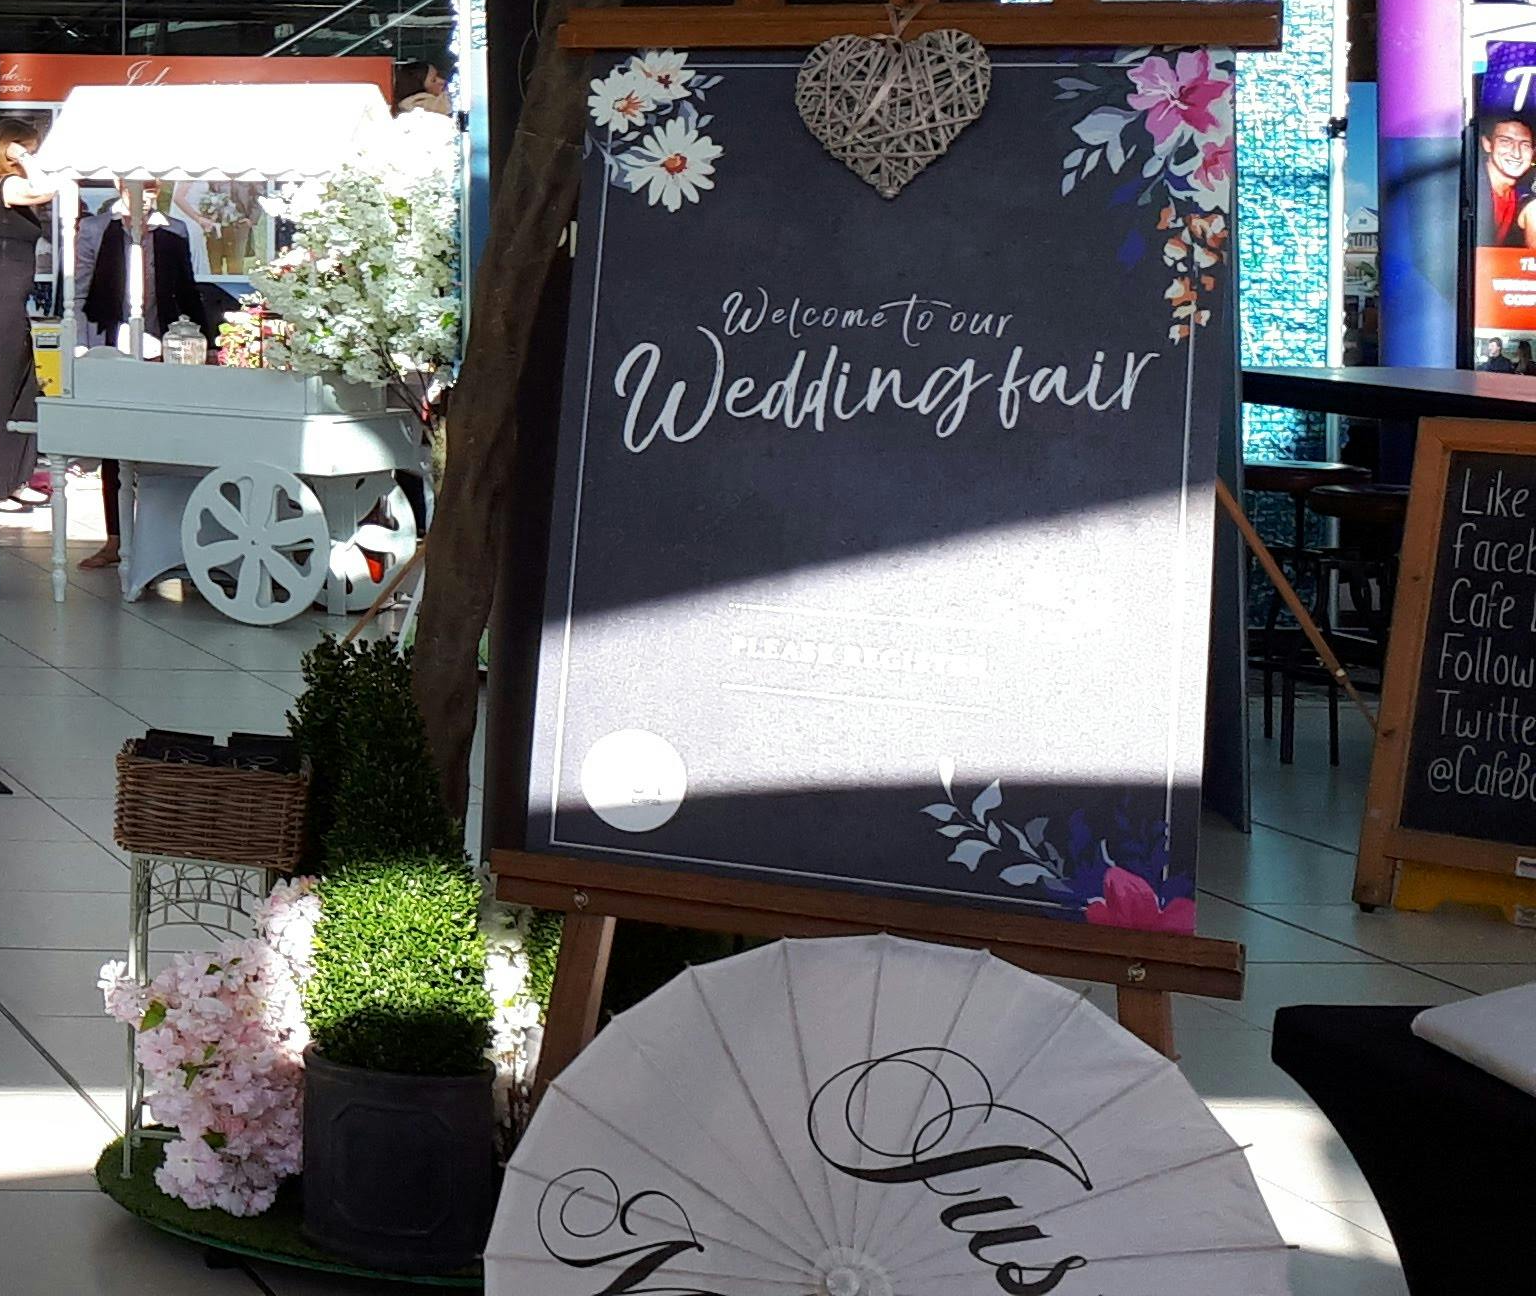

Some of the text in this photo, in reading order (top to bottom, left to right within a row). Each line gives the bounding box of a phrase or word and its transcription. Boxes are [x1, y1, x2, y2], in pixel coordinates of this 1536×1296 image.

[722, 287, 1014, 347] Welcome to our
[613, 325, 1160, 455] Wedding fair
[1462, 468, 1529, 517] Like
[1452, 522, 1536, 575] faceb
[1449, 577, 1515, 629] Cafe
[731, 634, 842, 667] PLEASE
[1438, 632, 1536, 688] Follow
[1436, 689, 1536, 746] Twitte
[808, 1046, 1093, 1296] Jus
